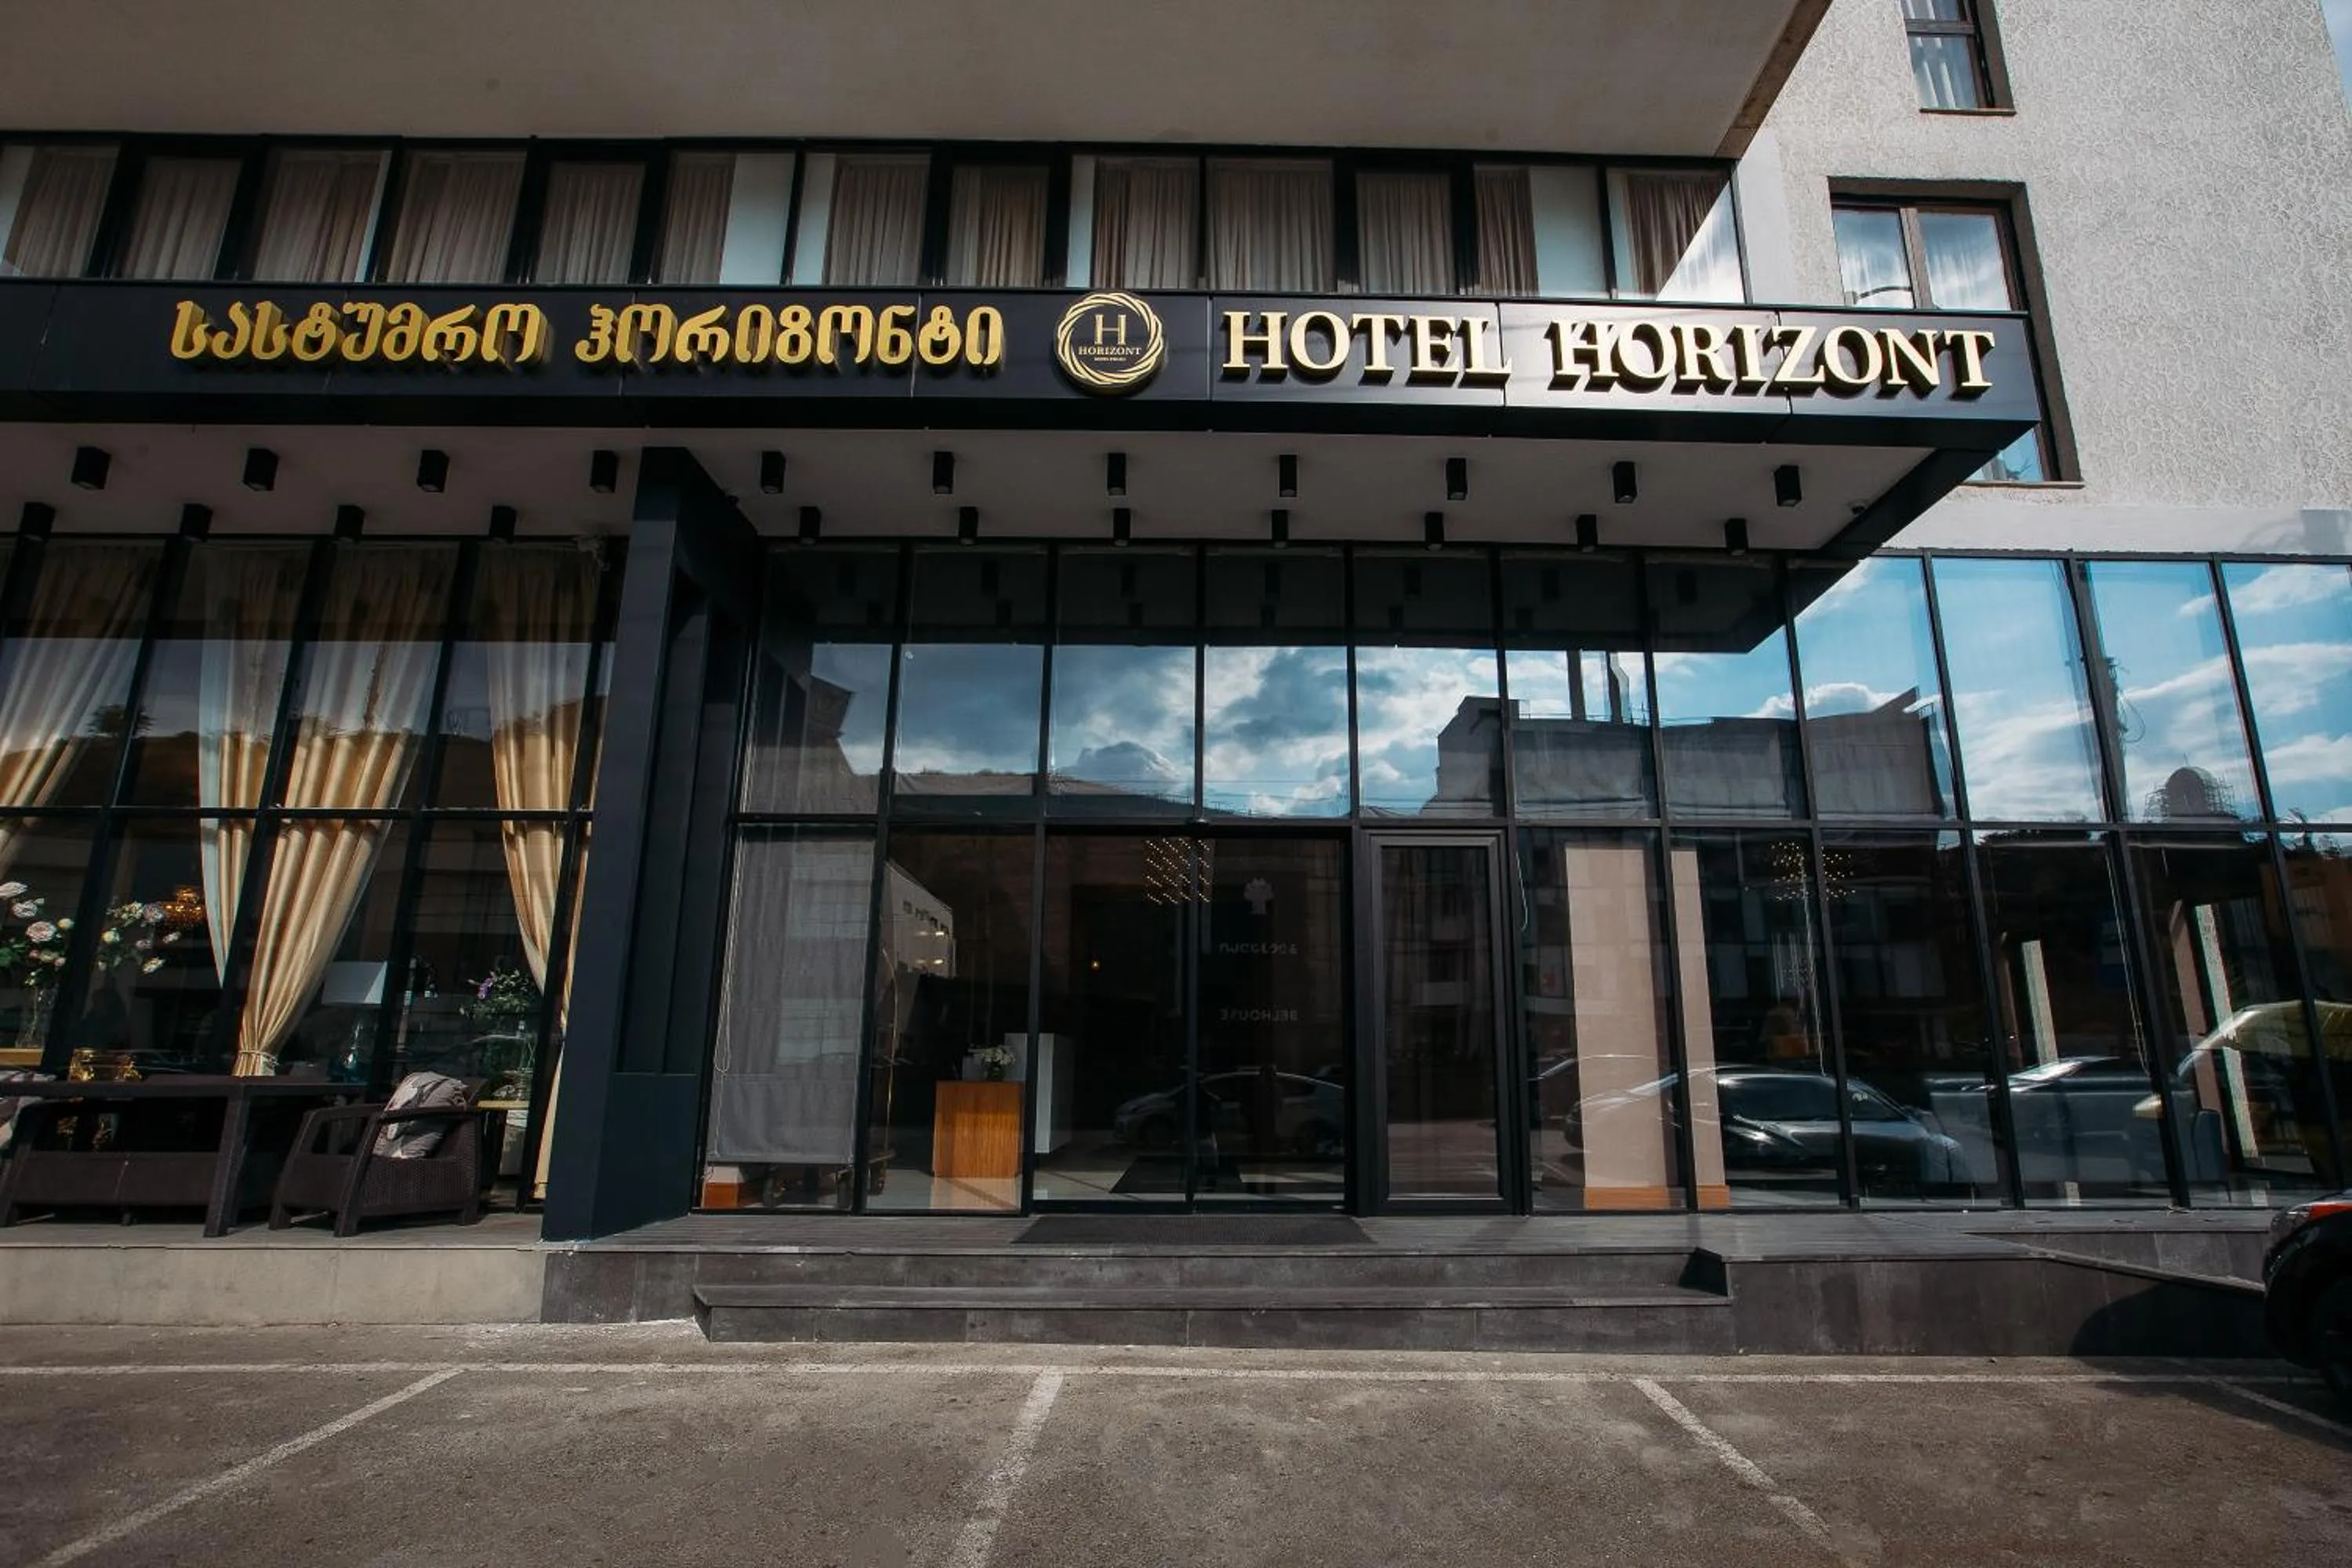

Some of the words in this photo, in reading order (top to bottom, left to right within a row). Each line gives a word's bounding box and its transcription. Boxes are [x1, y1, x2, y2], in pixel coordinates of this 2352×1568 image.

[170, 300, 543, 362] სასტუმრო
[575, 303, 1004, 365] ჰორიზონტი
[1078, 346, 1142, 355] HORIZONT
[1094, 314, 1127, 345] H
[1222, 310, 1512, 375] HOTEL
[1550, 319, 1996, 389] HORIZONT
